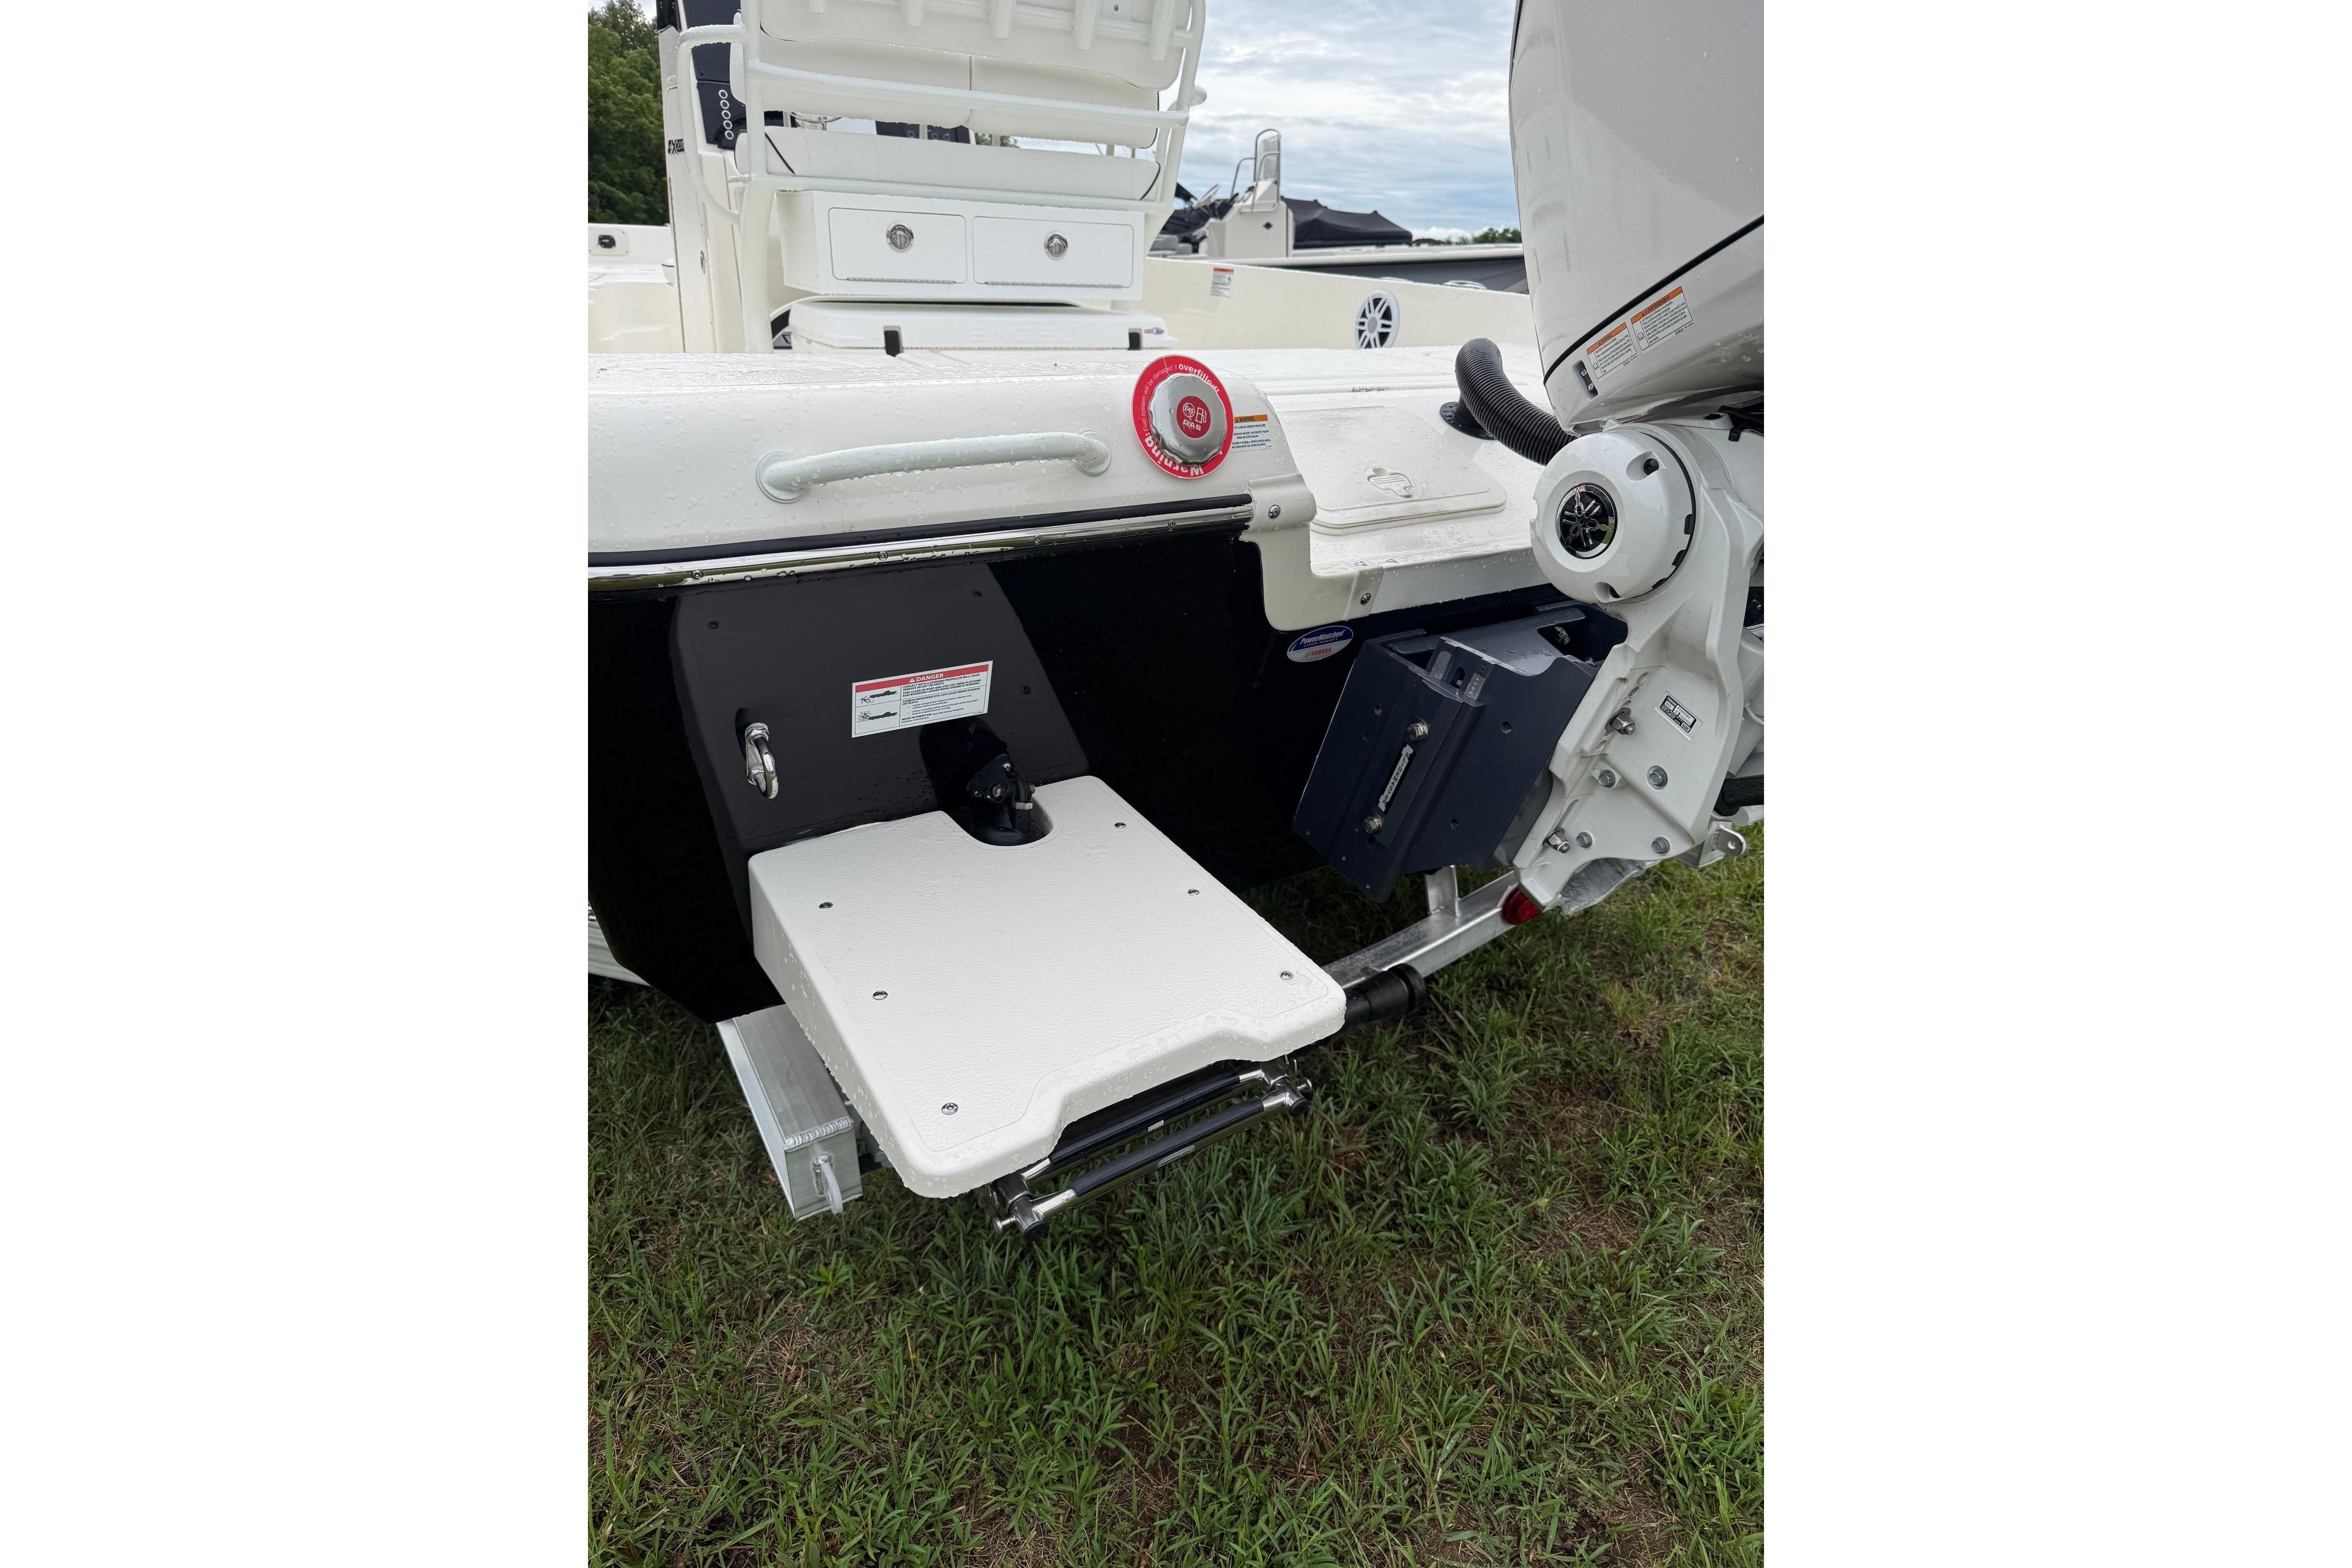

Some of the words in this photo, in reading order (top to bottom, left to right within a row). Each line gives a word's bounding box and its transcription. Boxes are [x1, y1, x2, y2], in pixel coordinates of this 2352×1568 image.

[1644, 295, 1670, 314] AVERTISSEMENT
[1600, 333, 1612, 343] WARNING
[1153, 365, 1173, 379] damaged
[1183, 419, 1201, 430] GAS
[1145, 433, 1203, 476] Warning:
[1300, 630, 1346, 645] PowerMatched
[1311, 647, 1332, 656] YAMAHA
[916, 673, 943, 681] DANGER
[1667, 697, 1677, 706] YAMAHA
[1382, 752, 1409, 804] SLIDEMASTER
